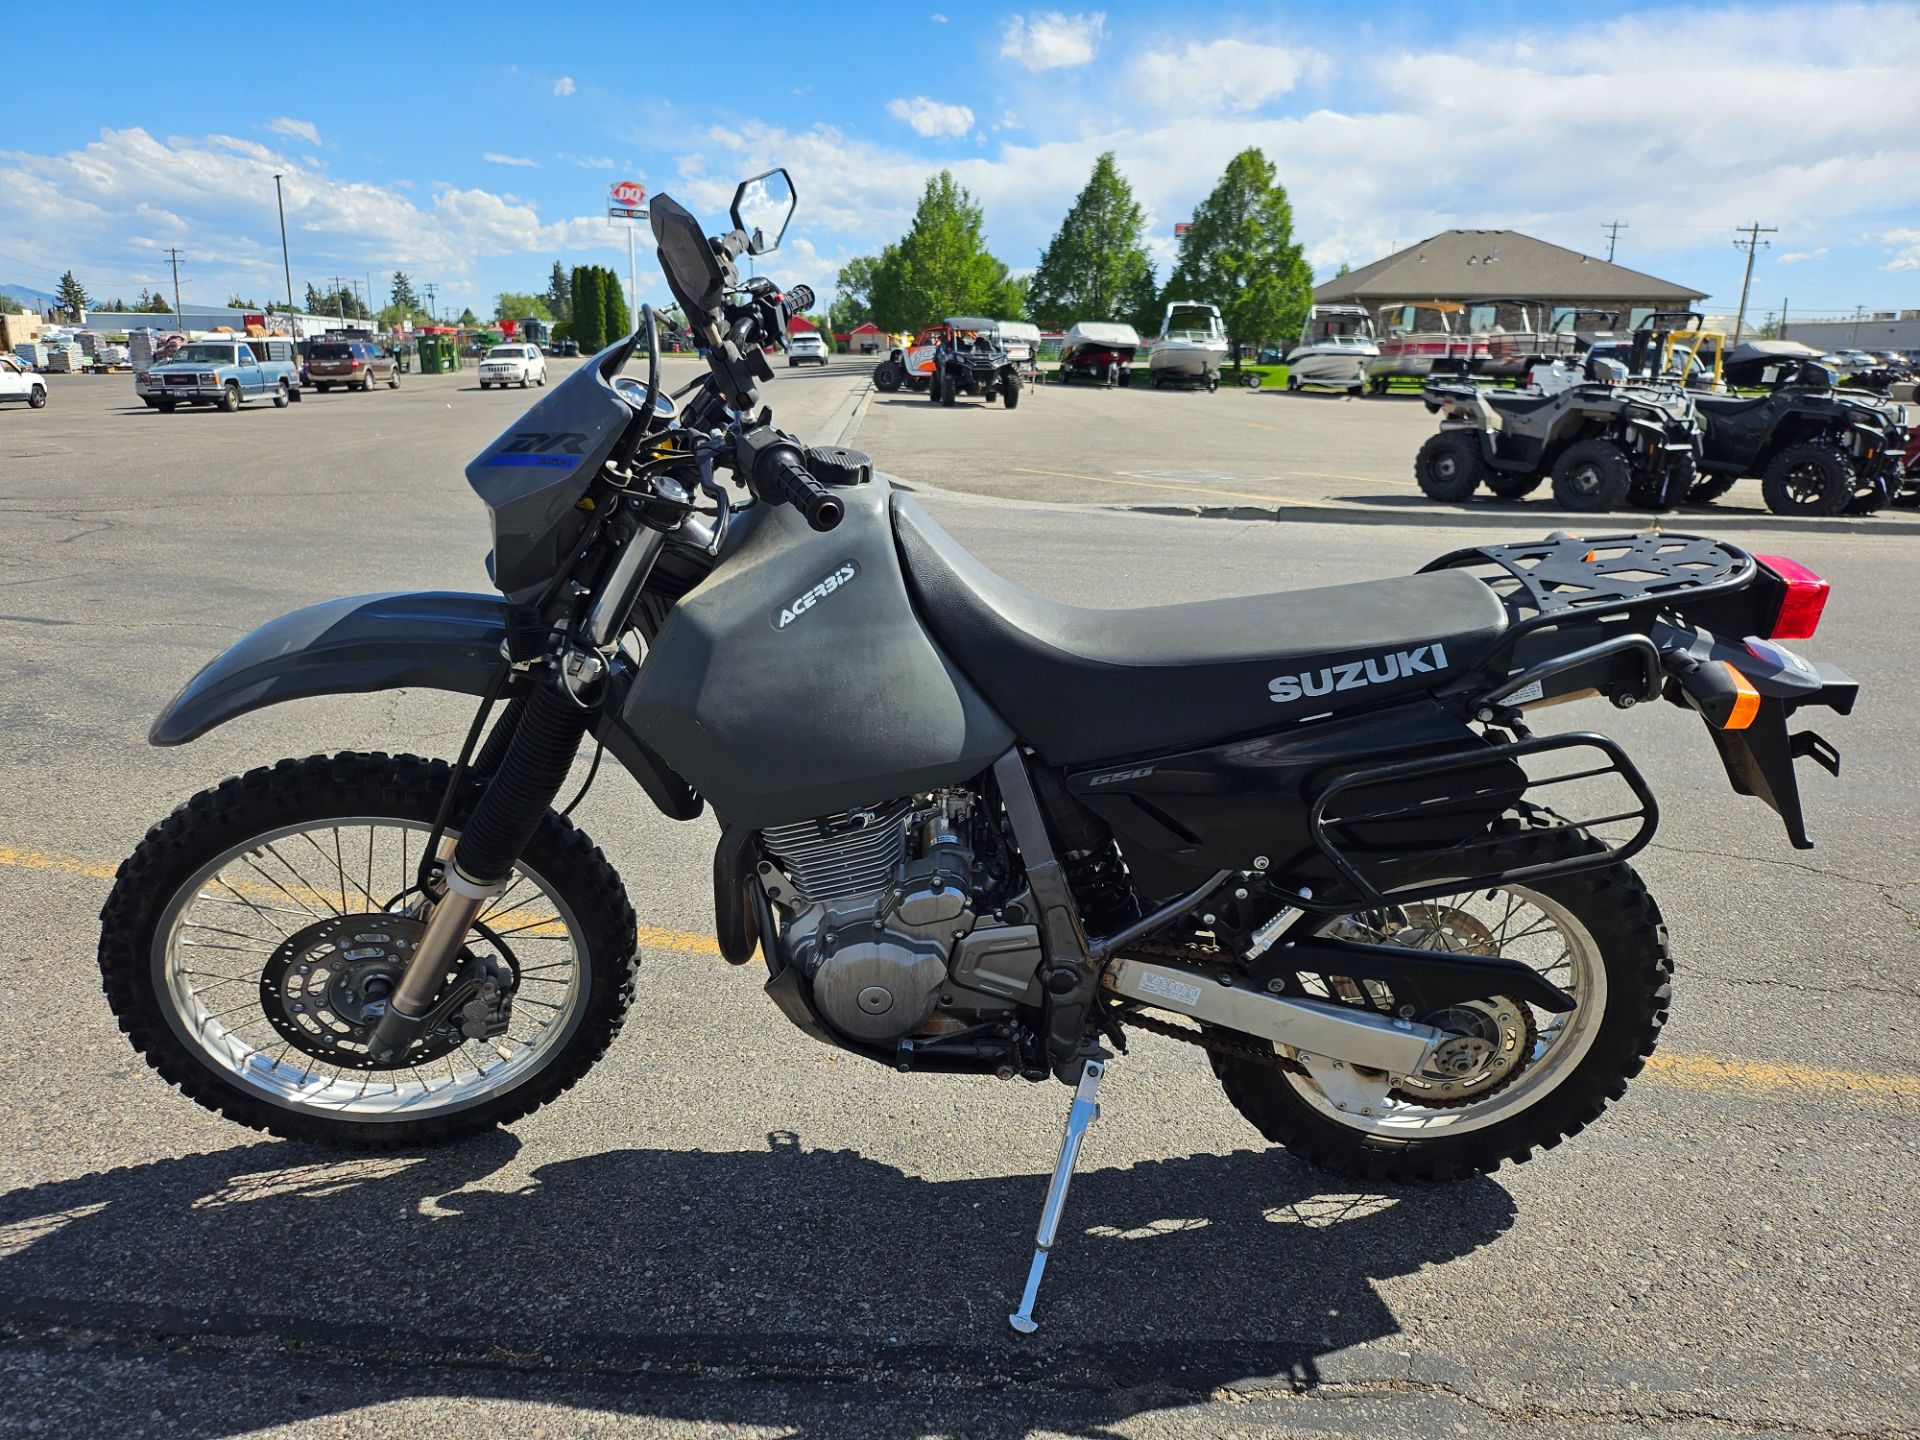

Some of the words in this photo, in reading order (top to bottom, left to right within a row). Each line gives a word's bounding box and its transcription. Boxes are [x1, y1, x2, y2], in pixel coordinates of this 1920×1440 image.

[618, 186, 642, 201] DQ
[1267, 643, 1449, 703] SUZUKI
[1089, 766, 1154, 786] 650
